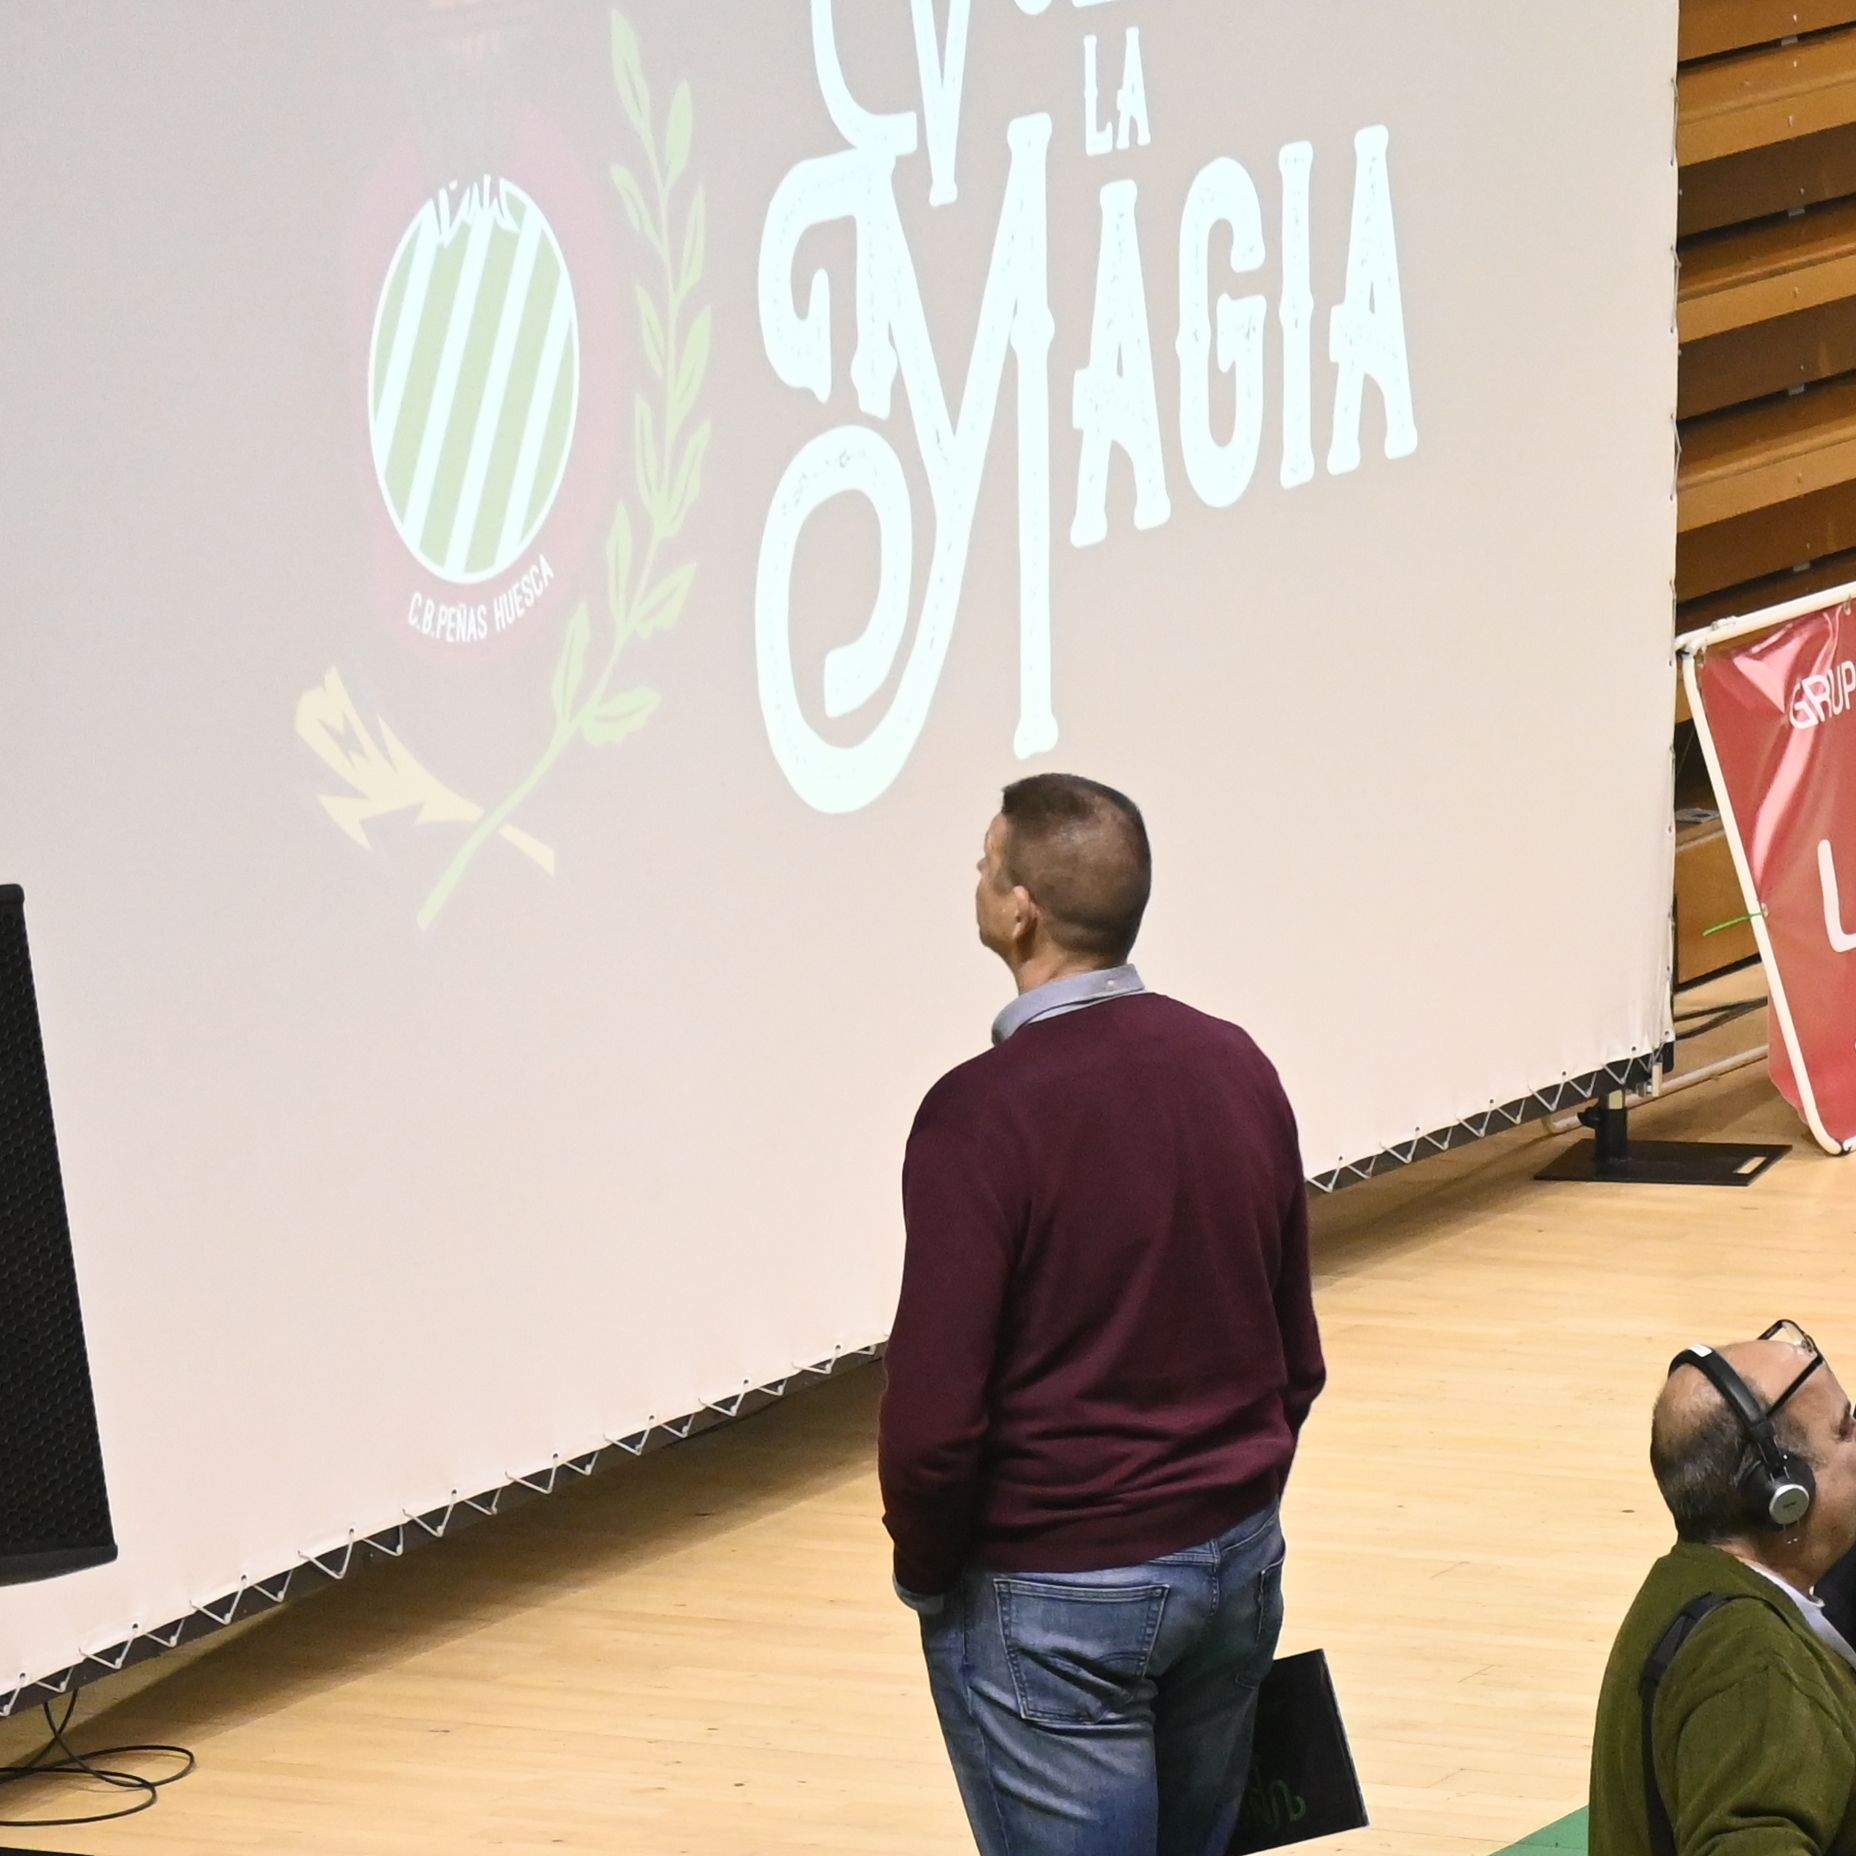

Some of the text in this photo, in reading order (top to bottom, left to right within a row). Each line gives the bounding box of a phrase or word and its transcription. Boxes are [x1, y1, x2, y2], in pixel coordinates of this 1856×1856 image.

[1083, 26, 1151, 156] LA
[755, 111, 1418, 813] MAGIA
[493, 553, 554, 632] HUESCA
